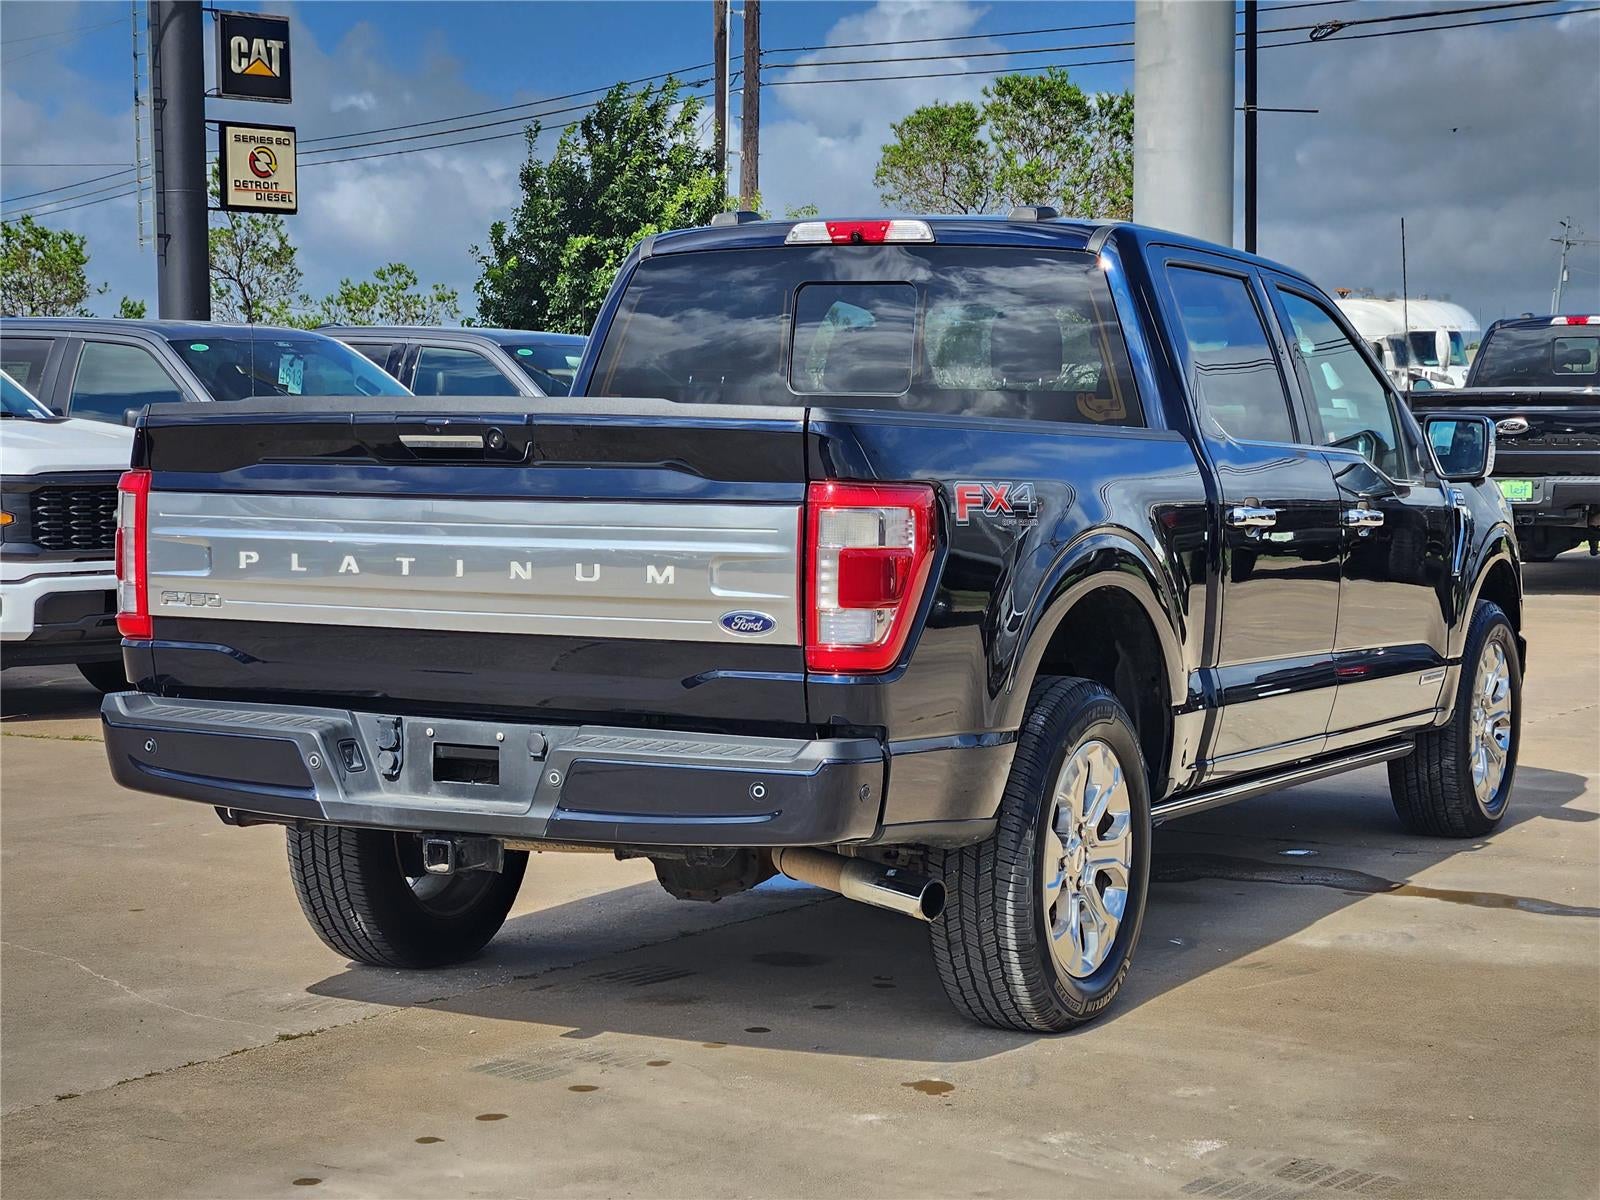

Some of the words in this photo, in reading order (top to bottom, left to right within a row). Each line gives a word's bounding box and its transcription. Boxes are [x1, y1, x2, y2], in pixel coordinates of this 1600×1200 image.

[230, 36, 284, 78] CAT
[234, 134, 273, 145] SERIES
[275, 137, 291, 146] 60
[234, 179, 279, 190] DETROIT
[256, 192, 293, 202] DIESEL
[953, 481, 1038, 526] FX4
[238, 551, 675, 585] PLATINUM
[161, 590, 222, 608] F-150
[731, 615, 763, 631] Ford
